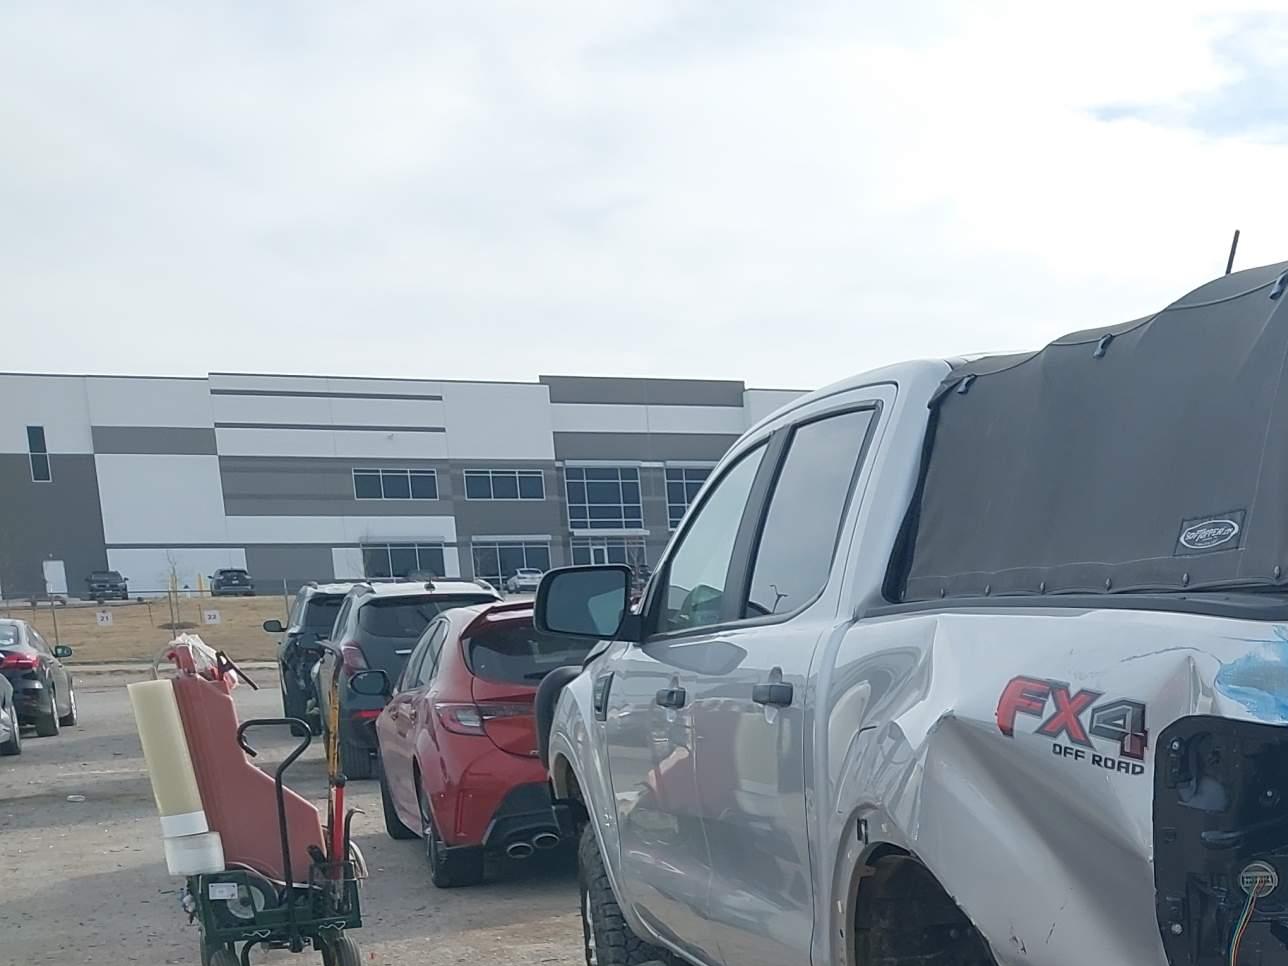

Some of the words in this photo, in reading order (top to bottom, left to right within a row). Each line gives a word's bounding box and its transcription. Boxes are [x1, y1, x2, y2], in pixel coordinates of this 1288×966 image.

[996, 675, 1148, 760] FX4
[1052, 743, 1086, 761] OFF
[1091, 754, 1145, 775] ROAD
